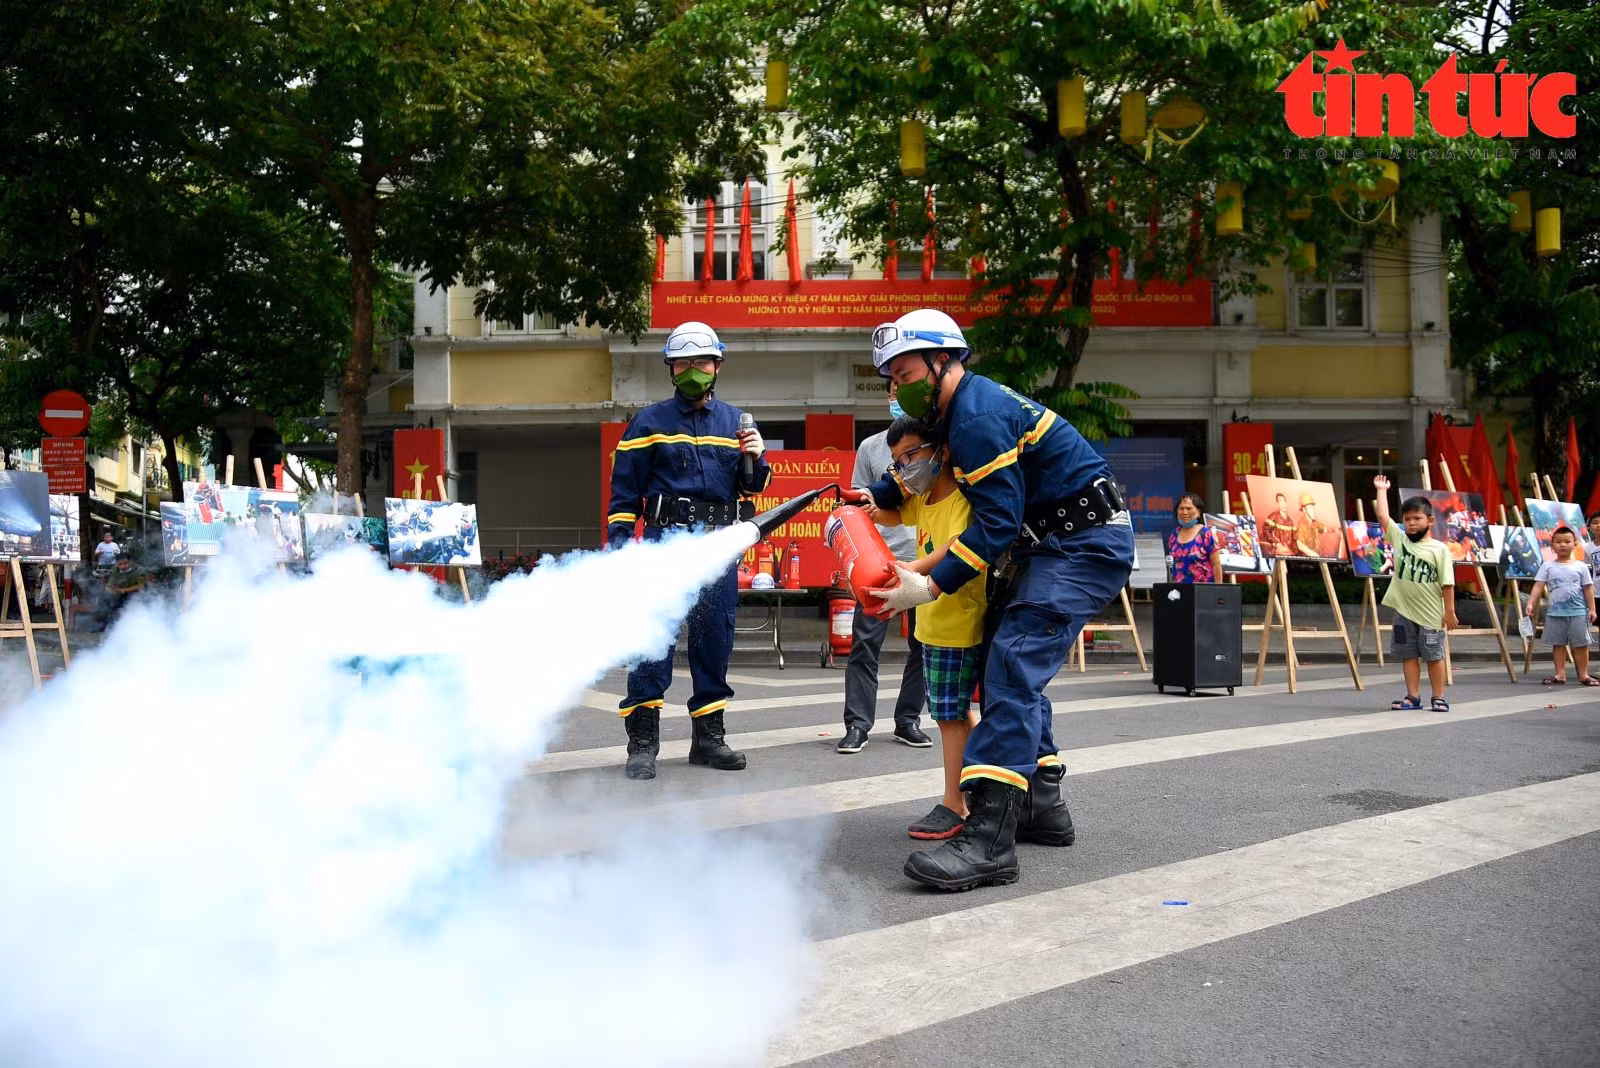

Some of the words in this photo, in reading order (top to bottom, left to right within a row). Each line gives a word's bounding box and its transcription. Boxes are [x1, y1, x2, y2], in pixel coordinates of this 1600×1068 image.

[667, 294, 693, 304] NHIỆT
[695, 294, 714, 304] LIỆT
[716, 293, 741, 303] CHÀO
[785, 294, 807, 304] NIỆM
[821, 294, 840, 302] NĂM
[843, 293, 868, 302] NGÀY
[813, 304, 834, 314] NIỆM
[837, 305, 852, 313] 132
[853, 304, 872, 313] NĂM
[874, 304, 899, 313] NGÀY
[805, 458, 840, 474] KIẾM
[790, 520, 821, 538] HOÀN
